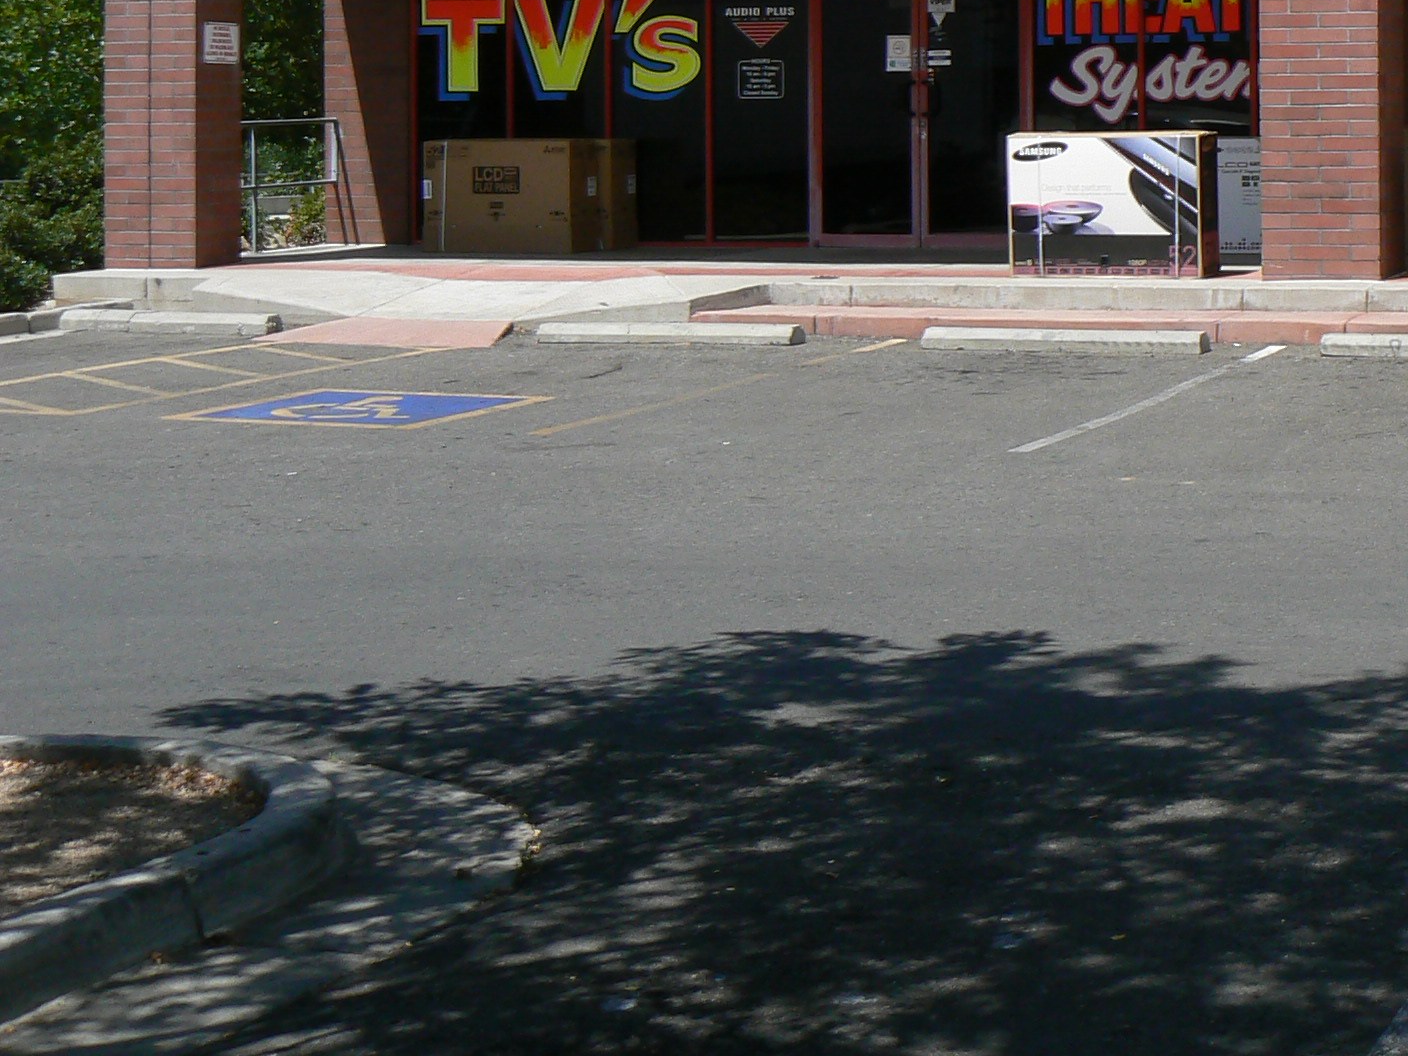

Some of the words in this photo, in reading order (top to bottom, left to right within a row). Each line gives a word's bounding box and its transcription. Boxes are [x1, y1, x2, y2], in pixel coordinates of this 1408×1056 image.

[725, 7, 761, 17] AUDIO
[766, 7, 796, 17] PLUS
[1018, 146, 1063, 157] SAMSUNG
[474, 166, 503, 182] LCD
[474, 182, 494, 193] FLAT
[496, 181, 520, 193] PANEL
